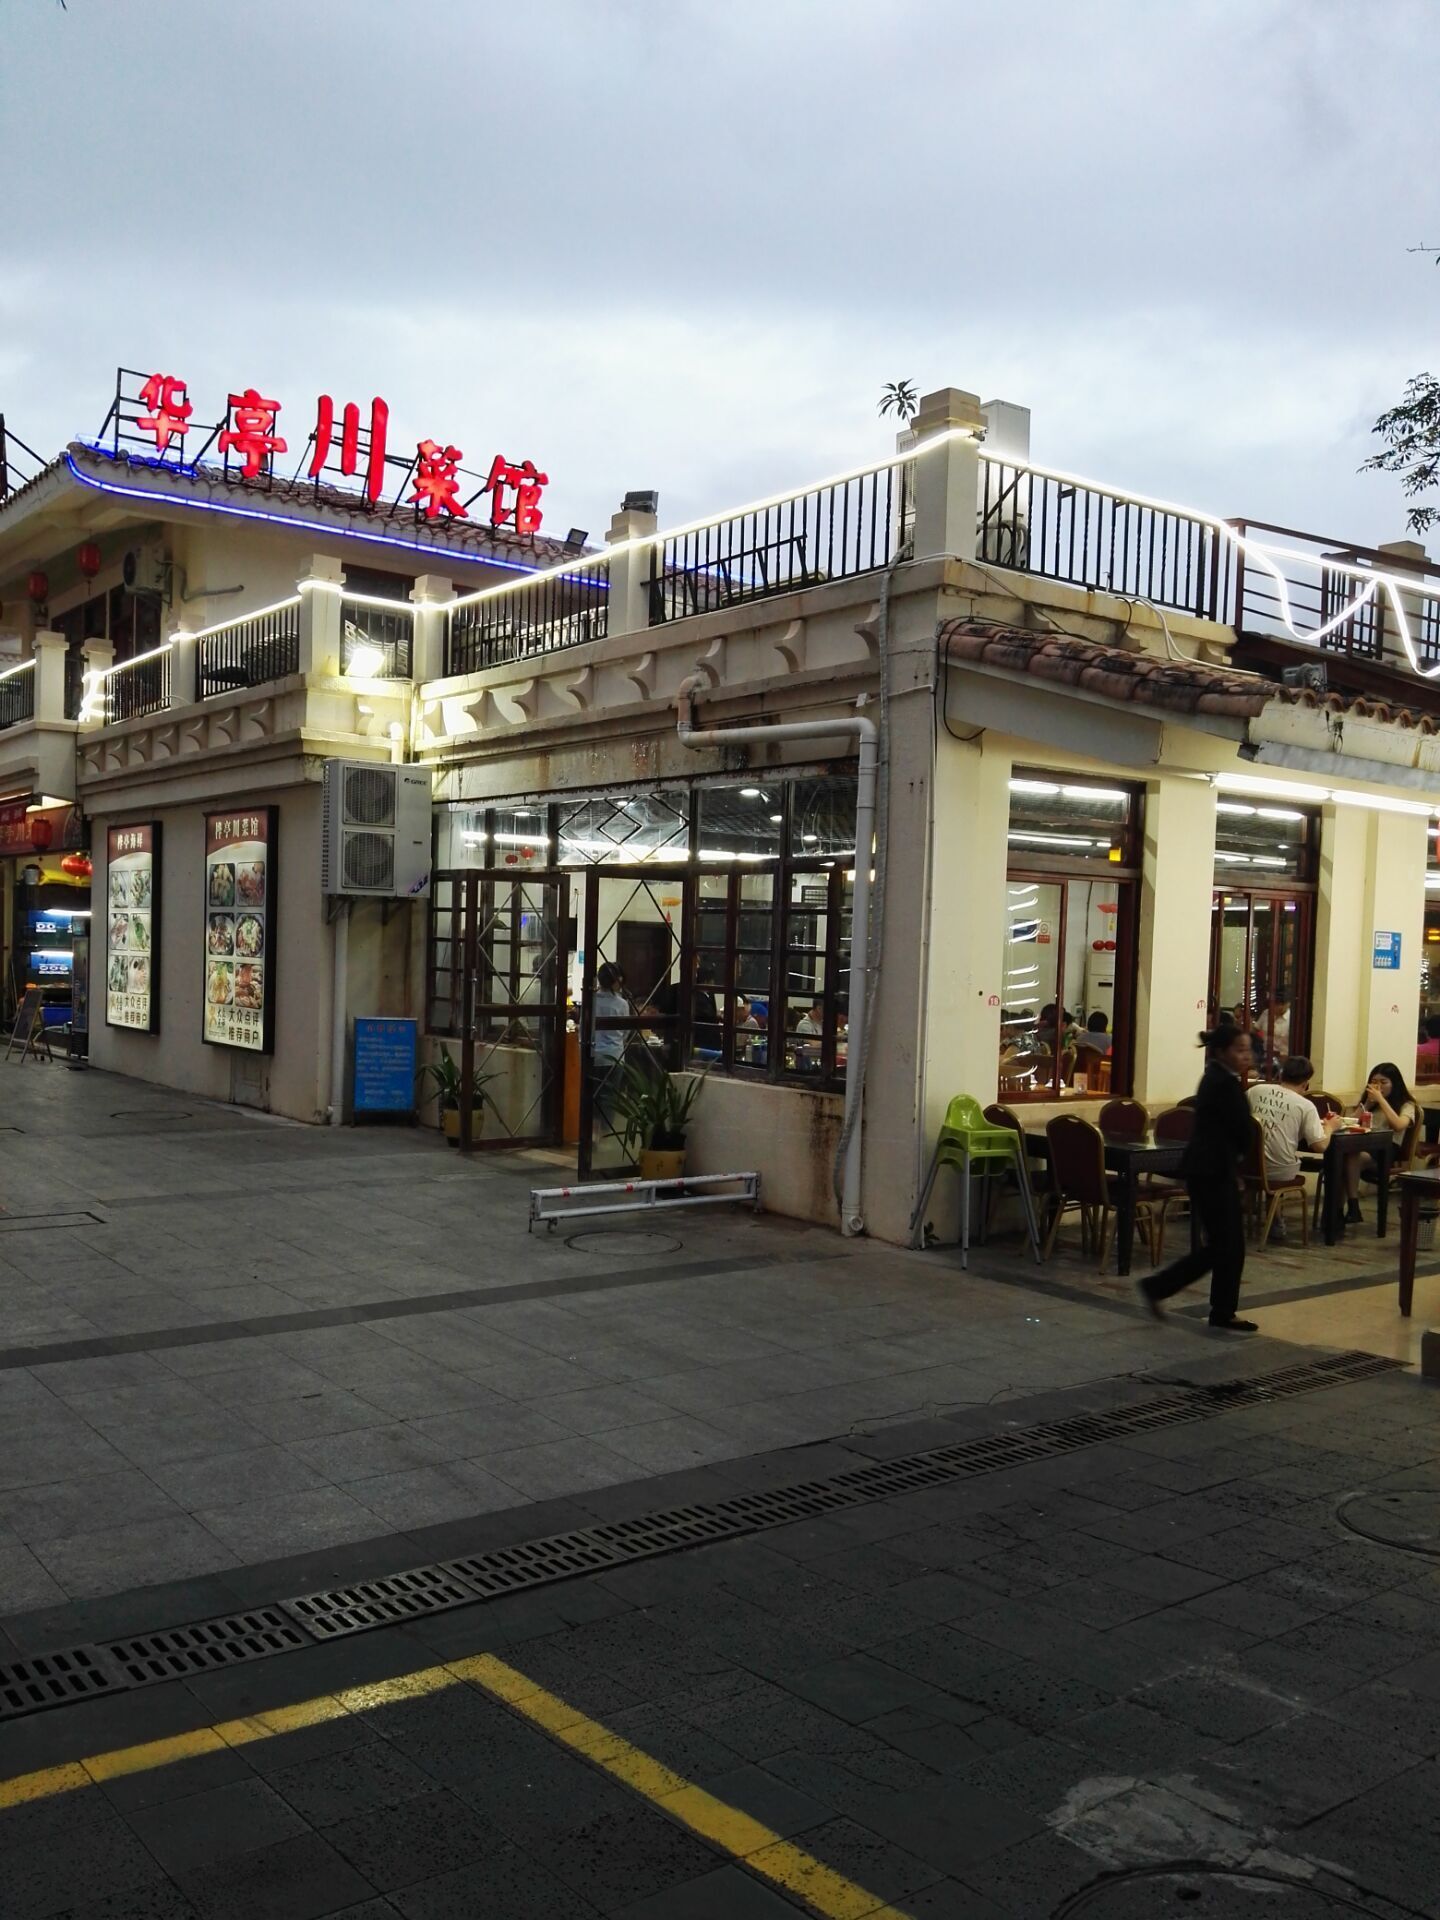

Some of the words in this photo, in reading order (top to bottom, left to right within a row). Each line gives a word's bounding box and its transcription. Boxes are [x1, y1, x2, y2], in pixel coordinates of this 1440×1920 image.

[136, 373, 549, 535] 华亭川菜馆
[229, 1008, 259, 1026] 大众点评
[229, 1027, 259, 1044] 推荐商户
[1269, 1089, 1288, 1098] MY
[1257, 1095, 1291, 1112] MAMA
